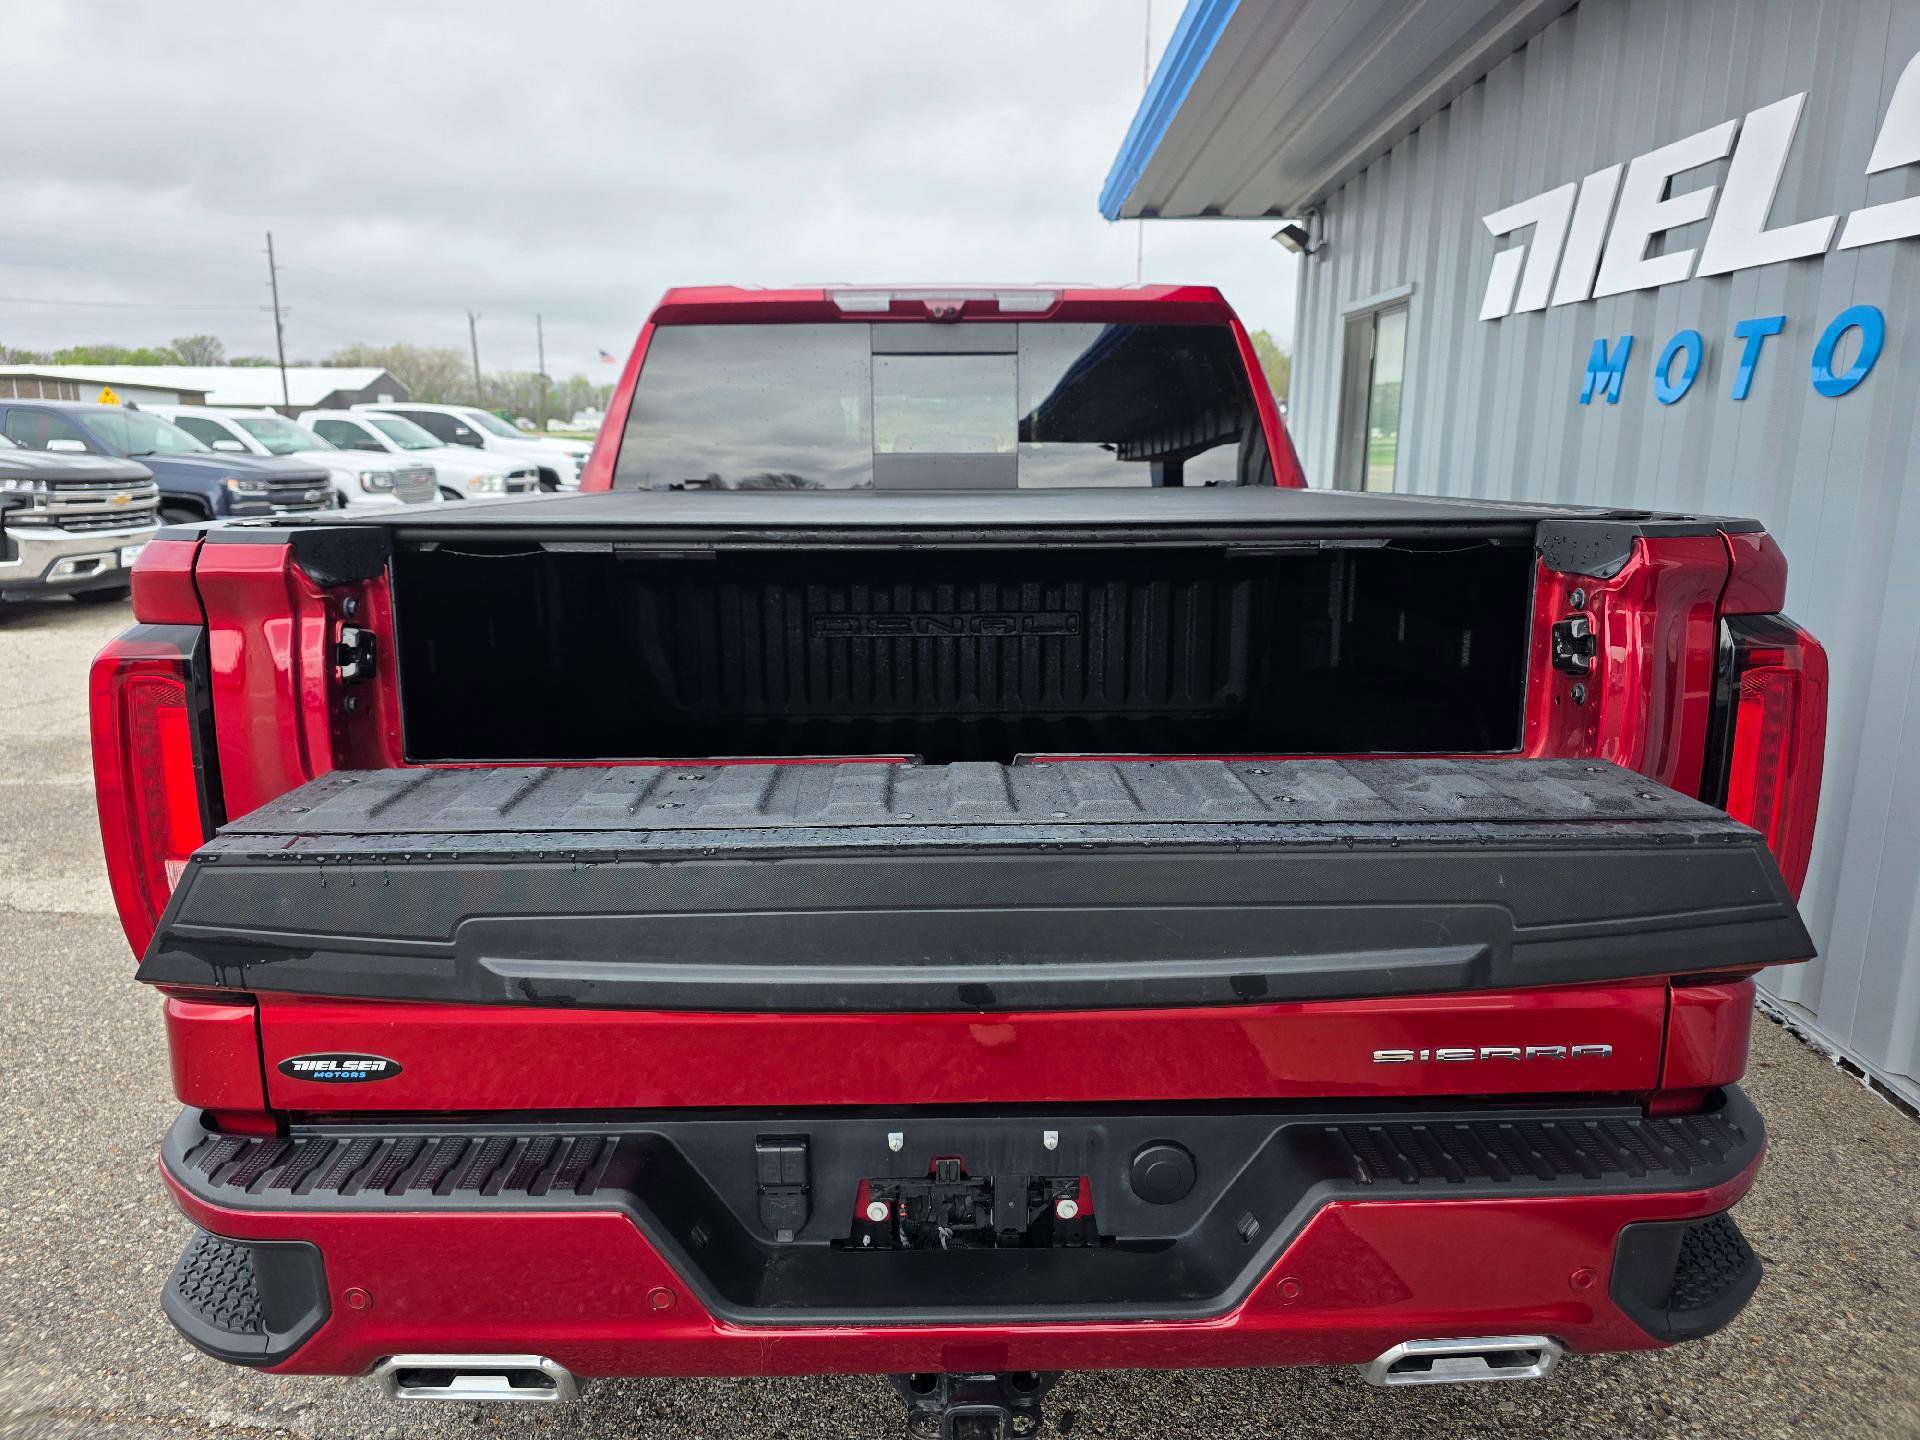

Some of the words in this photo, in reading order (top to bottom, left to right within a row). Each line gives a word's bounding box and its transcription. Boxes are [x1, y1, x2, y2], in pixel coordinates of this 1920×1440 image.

[1580, 305, 1885, 404] MOTO
[813, 613, 1080, 636] DENALI
[1373, 1044, 1613, 1063] SIERRA
[292, 1061, 386, 1071] NIELSEN
